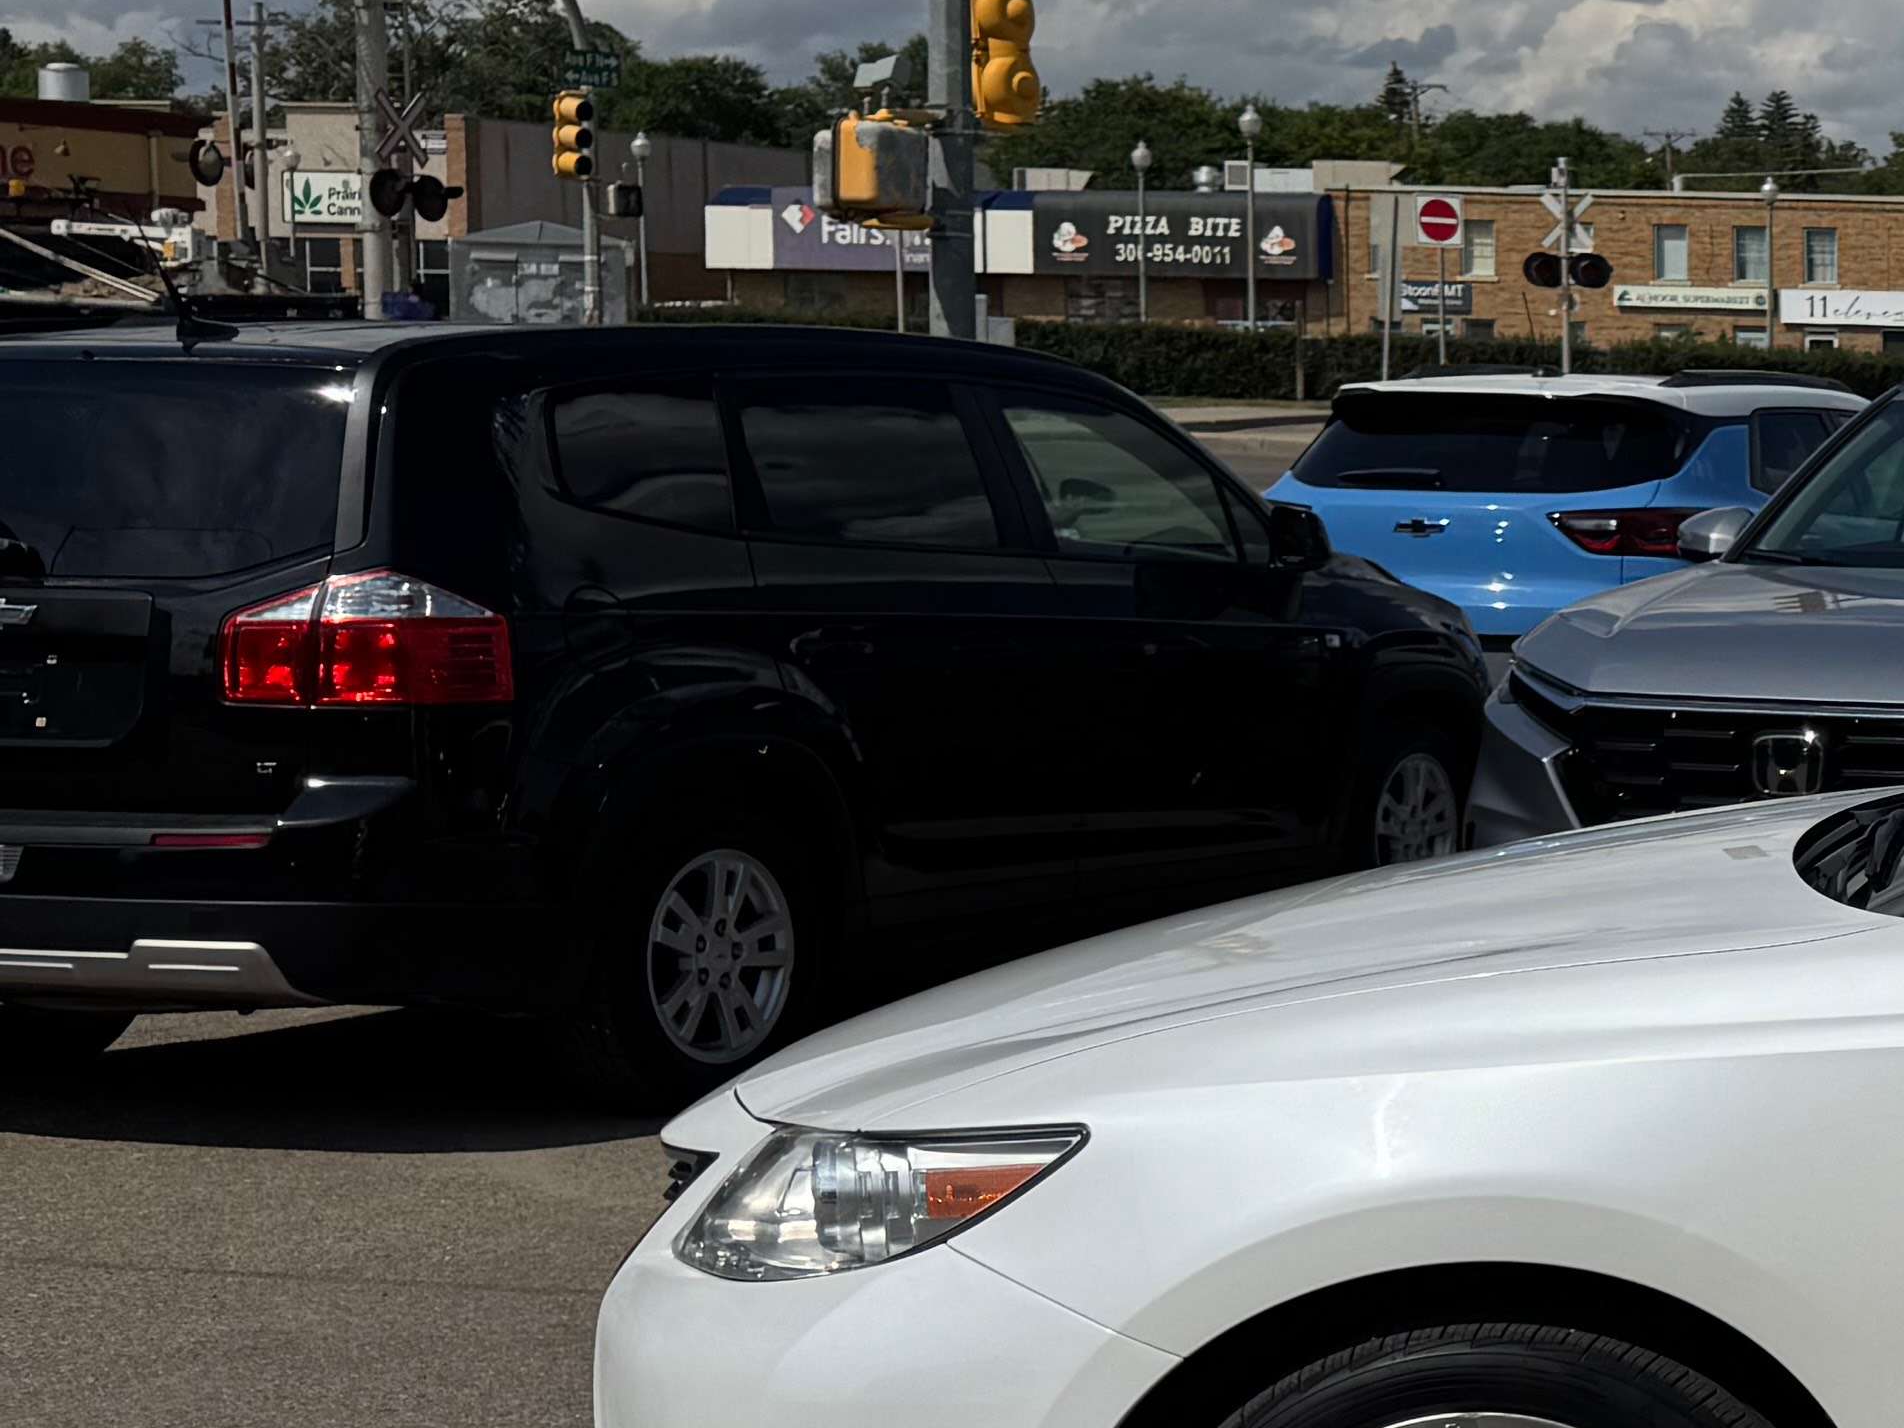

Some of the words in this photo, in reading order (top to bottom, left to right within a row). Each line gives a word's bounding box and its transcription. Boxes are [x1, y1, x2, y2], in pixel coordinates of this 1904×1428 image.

[327, 203, 361, 216] Cann
[1106, 215, 1170, 236] PIZZA
[1188, 217, 1243, 237] BITE
[1806, 295, 1828, 318] 11
